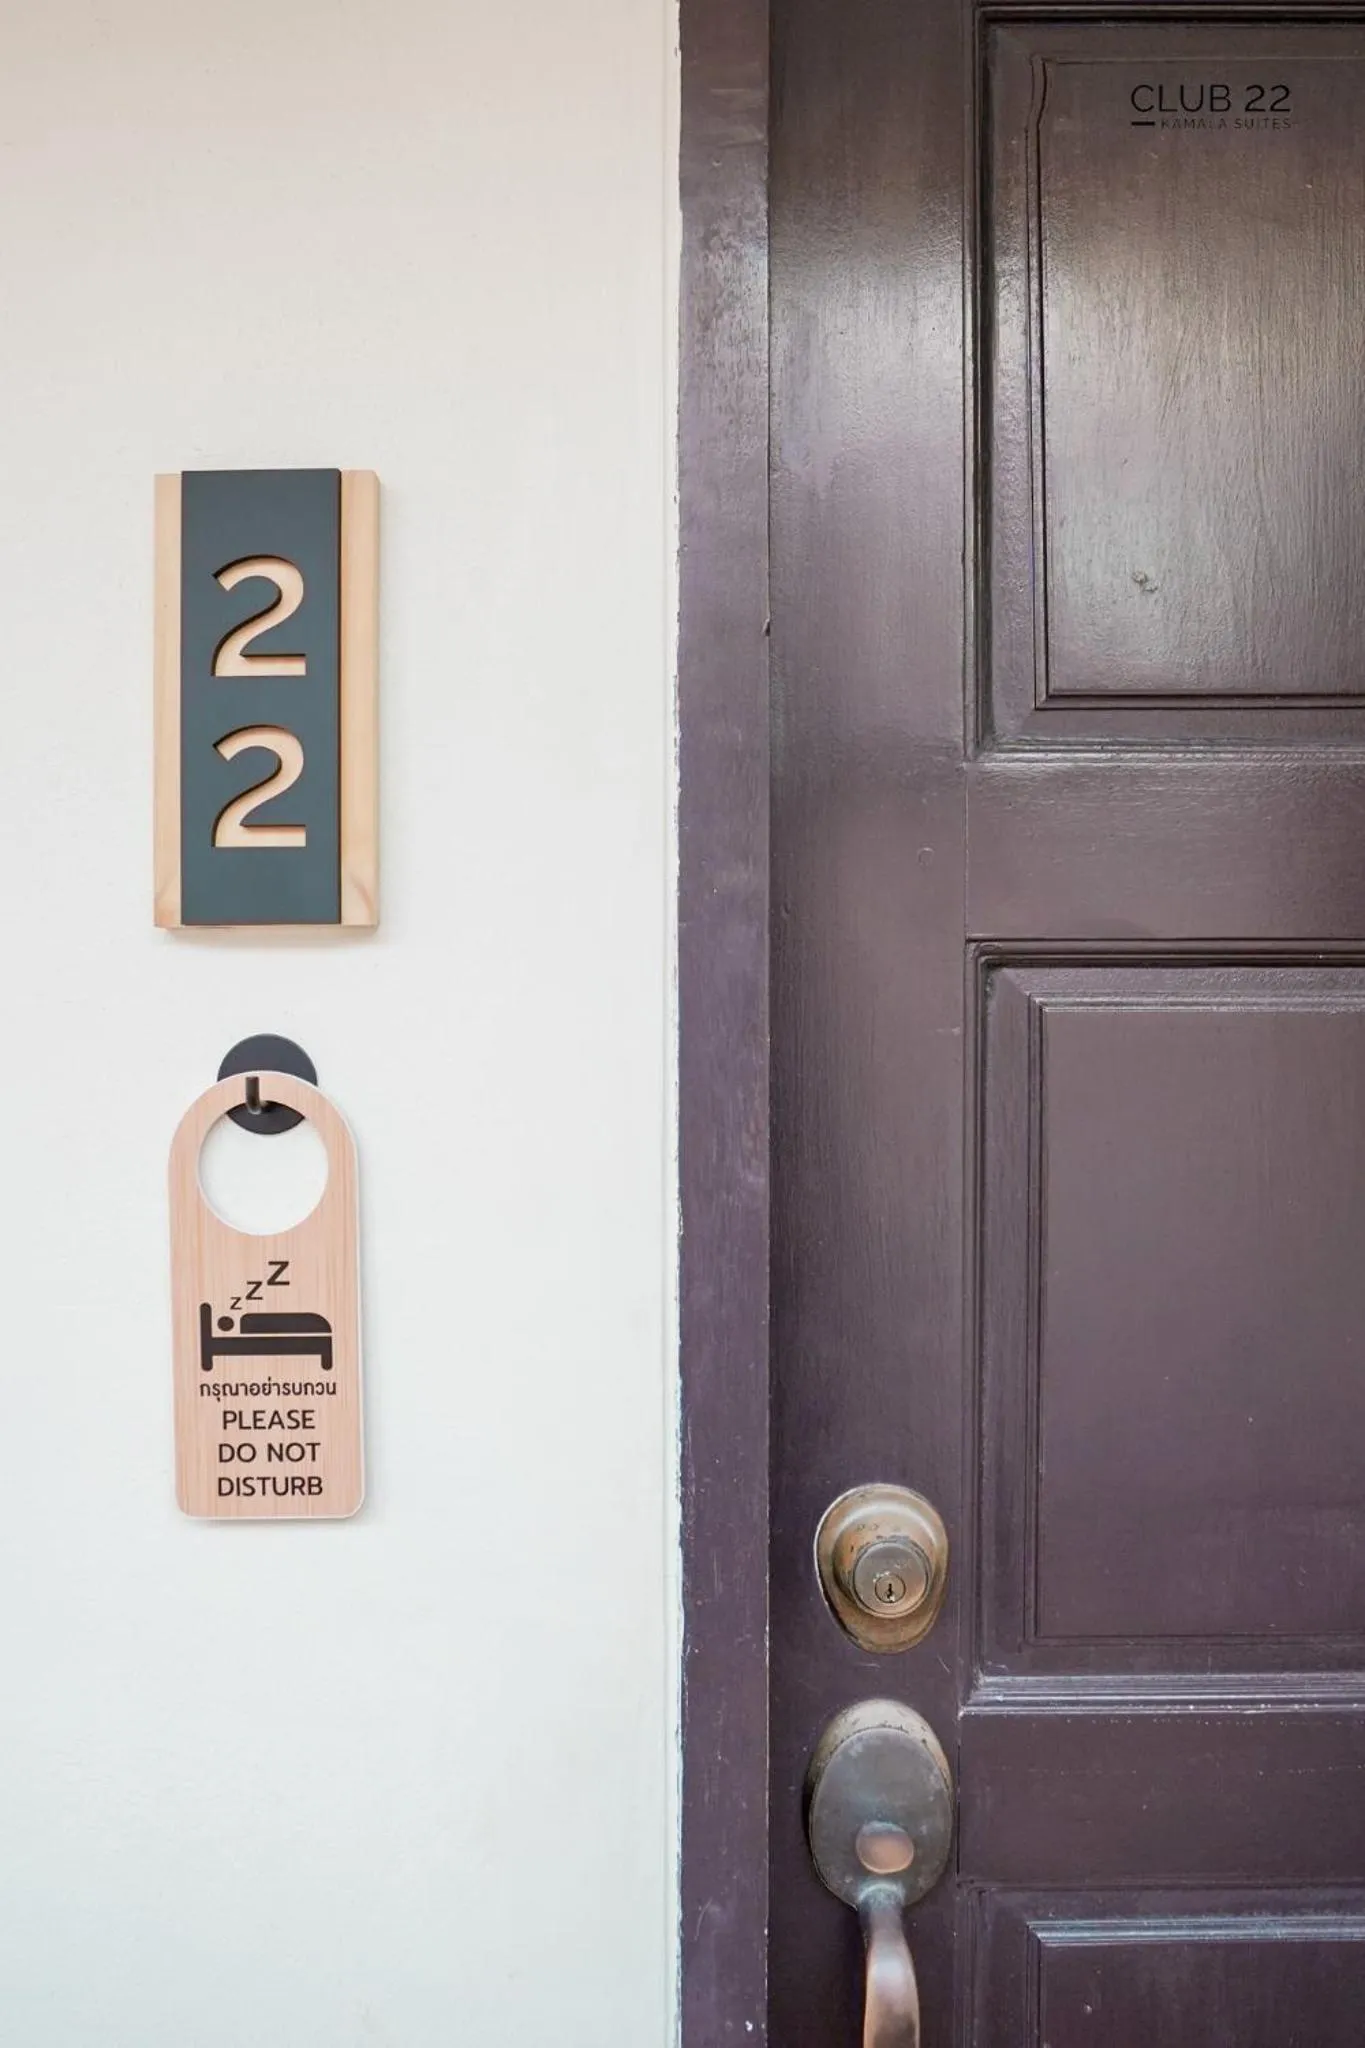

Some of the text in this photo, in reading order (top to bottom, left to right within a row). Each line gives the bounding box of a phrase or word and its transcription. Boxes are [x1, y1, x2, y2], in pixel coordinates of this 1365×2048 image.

[200, 1376, 337, 1402] กรุณาอย่ารบกวน
[223, 1409, 316, 1430] PLEASE
[218, 1442, 321, 1463] DO NOT
[218, 1476, 323, 1497] DISTURB
